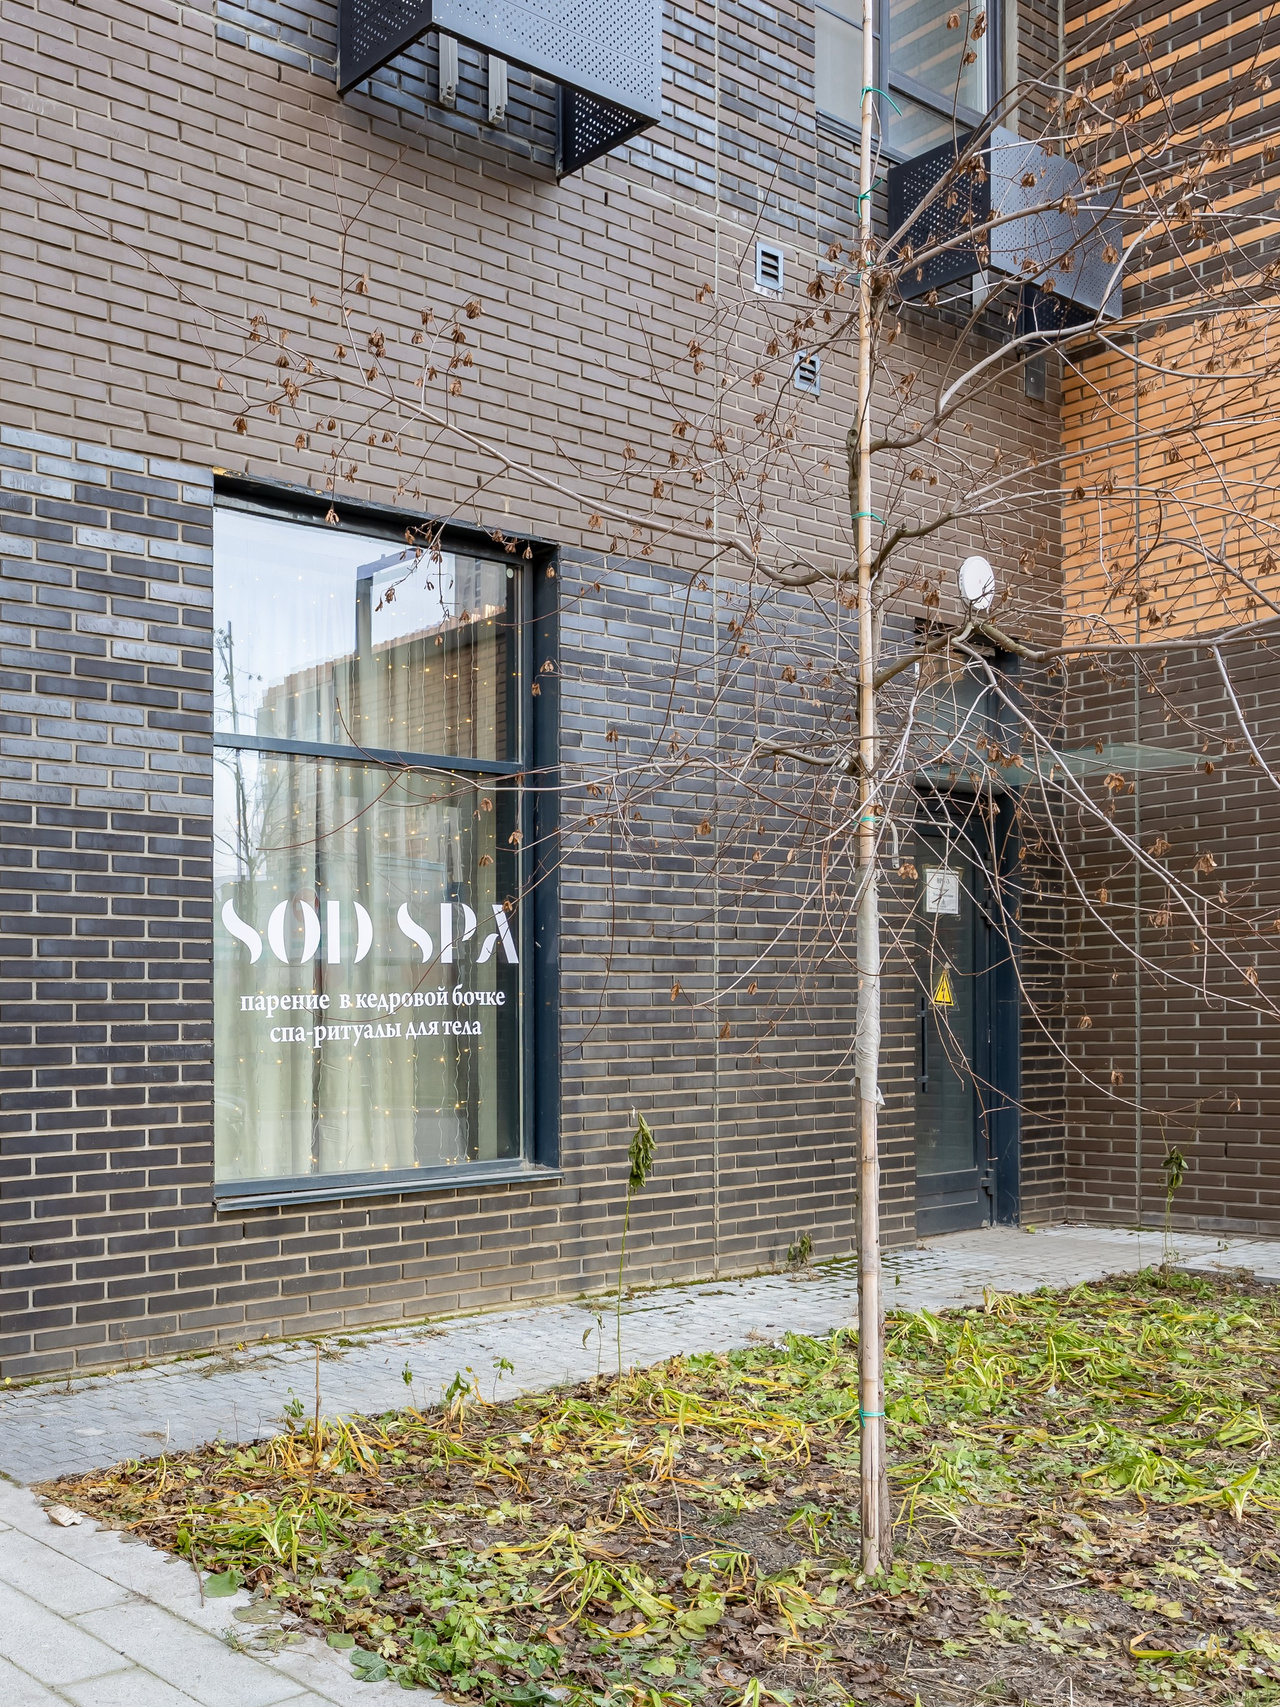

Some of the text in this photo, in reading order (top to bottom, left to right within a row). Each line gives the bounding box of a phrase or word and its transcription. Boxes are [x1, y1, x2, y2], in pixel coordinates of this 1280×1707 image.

[221, 898, 520, 965] SOD SPA
[240, 984, 506, 1017] парение в кедровой бочке
[269, 1019, 483, 1049] спа-ритуалы для тела
